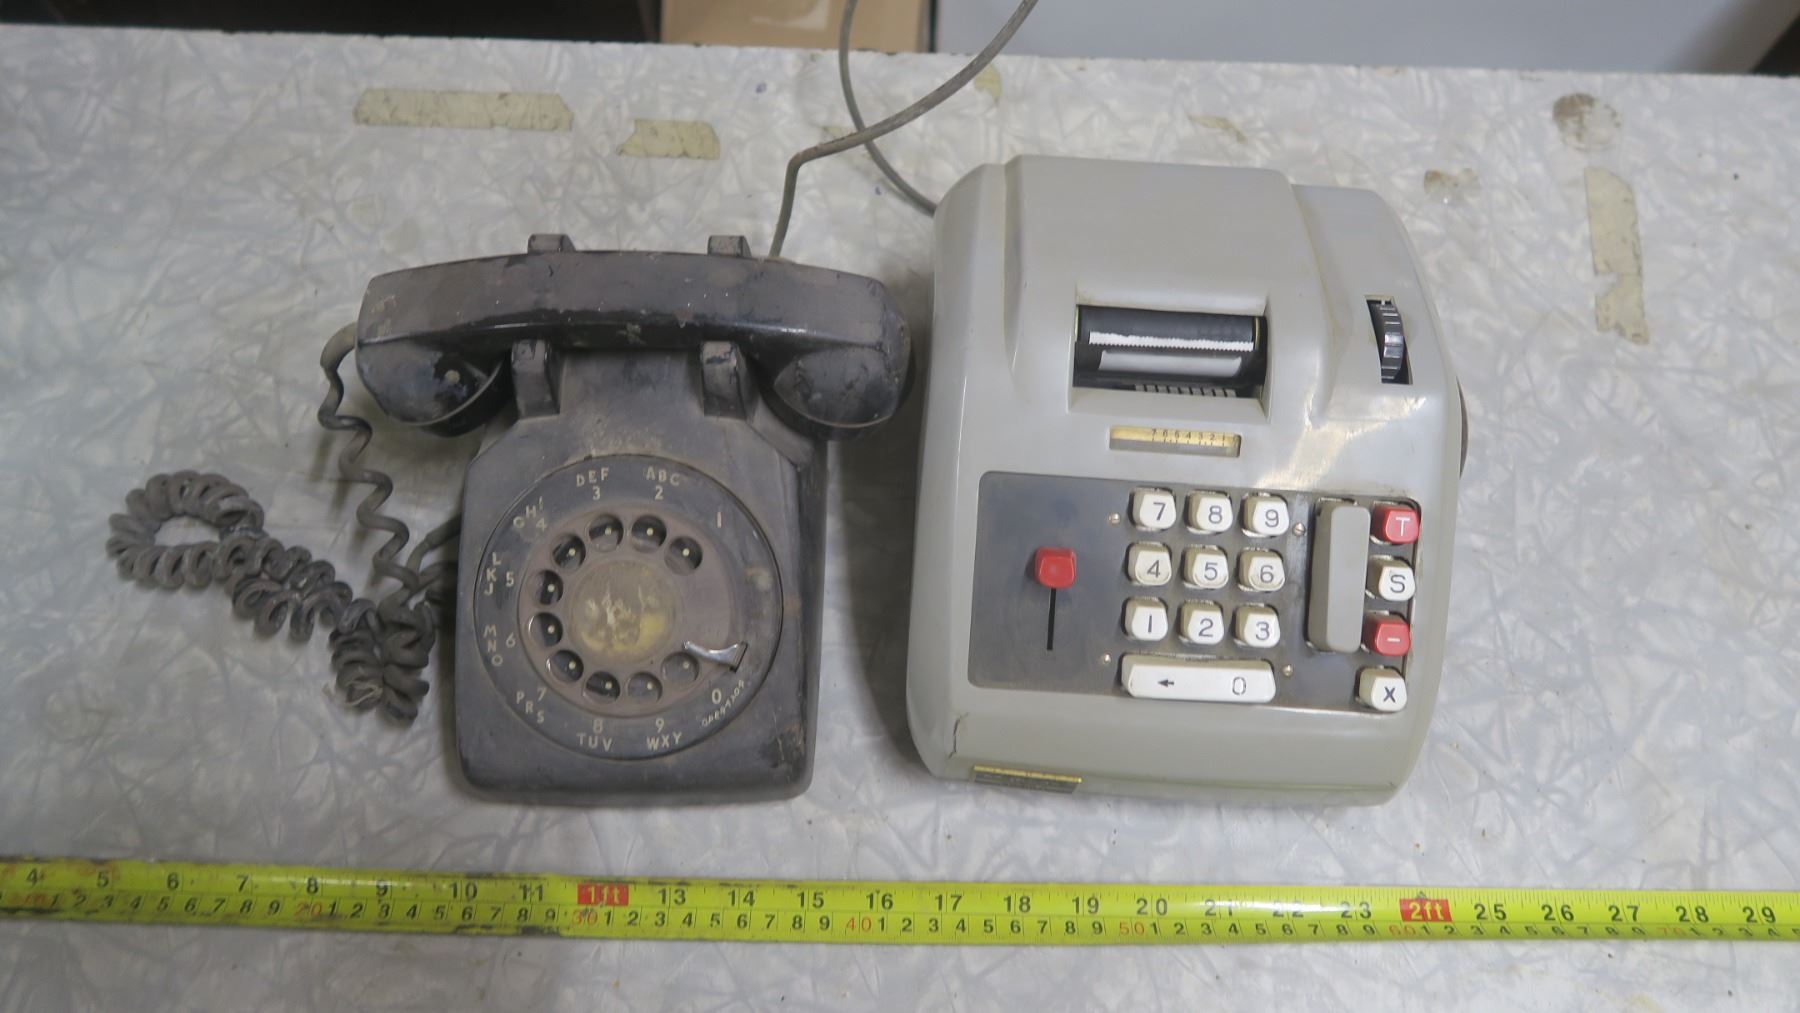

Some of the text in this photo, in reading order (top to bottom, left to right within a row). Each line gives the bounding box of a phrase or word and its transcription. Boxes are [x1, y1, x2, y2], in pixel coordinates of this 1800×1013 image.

[576, 467, 609, 487] DEF
[646, 466, 680, 485] ABC
[592, 486, 600, 500] 3
[655, 485, 664, 500] 2
[536, 518, 547, 531] 4
[1153, 502, 1280, 528] 7 8 9
[1395, 516, 1411, 537] T
[506, 572, 514, 587] 5
[1147, 560, 1274, 584] 4 5 6
[1390, 574, 1406, 593] S
[1198, 618, 1214, 637] 2
[1255, 621, 1270, 641] 3
[506, 632, 515, 648] 6
[537, 687, 547, 702] 7
[1232, 677, 1247, 695] 0
[1383, 686, 1396, 703] X
[593, 718, 603, 734] 8
[655, 717, 664, 733] 9
[577, 733, 613, 752] TUV
[646, 731, 682, 751] WXY
[27, 868, 38, 886] 4
[97, 871, 109, 887] 5
[167, 872, 179, 889] 6
[237, 875, 249, 891] 7
[306, 877, 319, 894] 8
[376, 879, 388, 896] 9
[450, 882, 477, 900] 10
[520, 884, 543, 901] 11
[589, 885, 620, 899] 1ft
[658, 888, 685, 905] 13
[728, 889, 755, 906] 14
[797, 891, 825, 908] 15
[866, 893, 893, 910] 16
[935, 894, 963, 912] 17
[1004, 895, 1031, 913] 18
[1071, 896, 1099, 914] 19
[1135, 898, 1168, 916] 20
[1204, 899, 1233, 917] 21
[1340, 901, 1371, 919] 23
[1409, 902, 1444, 920] 2ft
[1474, 904, 1506, 921] 25
[1541, 905, 1574, 922] 26
[1608, 905, 1640, 922] 27
[1675, 906, 1709, 923] 28
[1743, 906, 1776, 923] 29
[51, 894, 59, 907] 1
[104, 895, 114, 908] 3
[131, 896, 142, 909] 4
[157, 897, 169, 911] 5
[185, 898, 196, 912] 6
[213, 898, 225, 913] 7
[239, 900, 252, 914] 8
[268, 901, 280, 915] 9
[294, 902, 322, 917] 20
[329, 903, 337, 918] 1
[350, 903, 363, 918] 2
[378, 904, 389, 919] 3
[406, 904, 417, 919] 4
[434, 905, 445, 919] 5
[461, 907, 473, 921] 6
[491, 907, 501, 921] 7
[517, 908, 528, 921] 8
[544, 909, 555, 922] 9
[572, 910, 598, 926] 30
[604, 911, 612, 925] 1
[628, 911, 639, 926] 2
[655, 912, 665, 927] 3
[682, 913, 693, 927] 4
[710, 913, 720, 927] 5
[737, 914, 747, 929] 6
[765, 914, 775, 929] 7
[792, 915, 802, 930] 8
[819, 916, 830, 930] 9
[846, 917, 872, 932] 40
[879, 917, 885, 931] 1
[902, 918, 912, 932] 2
[929, 918, 939, 933] 3
[956, 919, 966, 933] 4
[983, 919, 994, 933] 5
[1010, 920, 1021, 934] 6
[1037, 920, 1048, 934] 7
[1065, 920, 1076, 934] 8
[1092, 921, 1103, 935] 9
[1119, 921, 1145, 936] 50
[1151, 922, 1158, 935] 1
[1174, 922, 1185, 935] 2
[1201, 923, 1212, 936] 3
[1229, 923, 1239, 936] 4
[1255, 923, 1267, 936] 5
[1282, 923, 1293, 936] 6
[1308, 923, 1319, 936] 7
[1336, 924, 1348, 936] 8
[1363, 924, 1375, 936] 9
[1389, 924, 1416, 936] 60
[1444, 925, 1455, 935] 2
